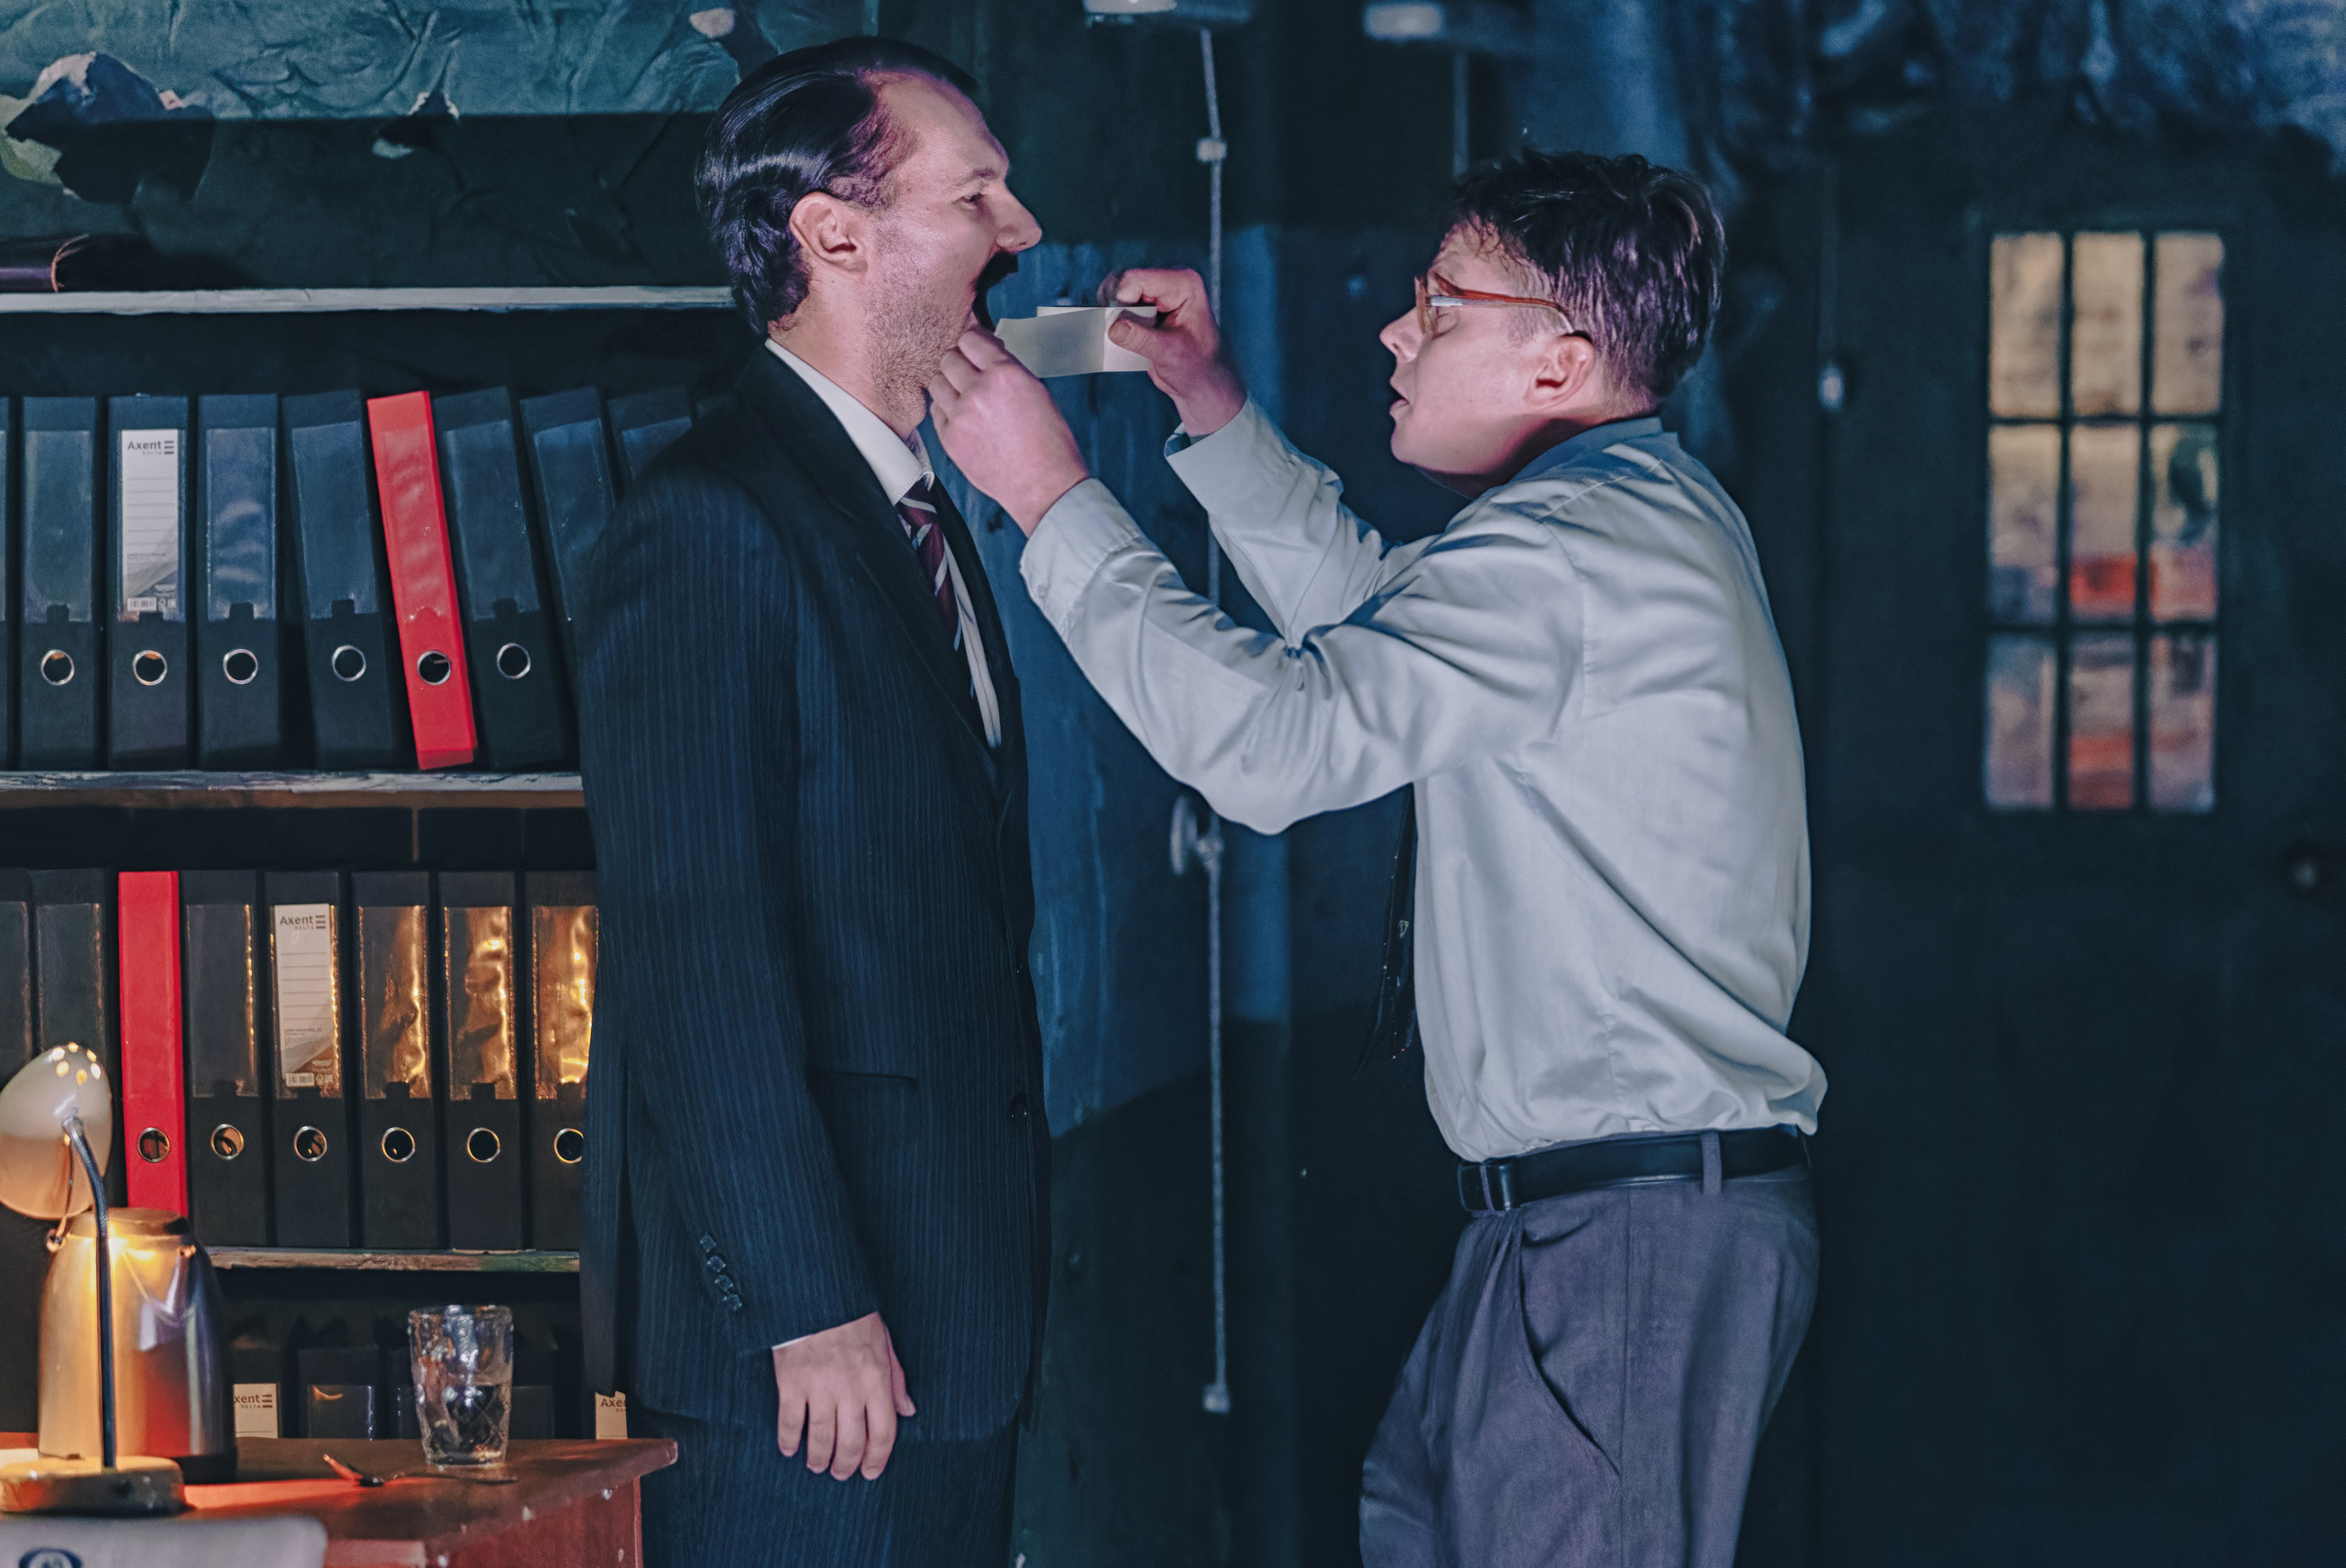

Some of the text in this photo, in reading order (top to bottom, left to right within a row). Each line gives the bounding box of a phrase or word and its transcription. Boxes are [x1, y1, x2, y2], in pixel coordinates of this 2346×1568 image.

[127, 441, 161, 450] Axent
[280, 916, 313, 926] Axent
[234, 1394, 260, 1403] xent
[600, 1398, 626, 1408] Axe
